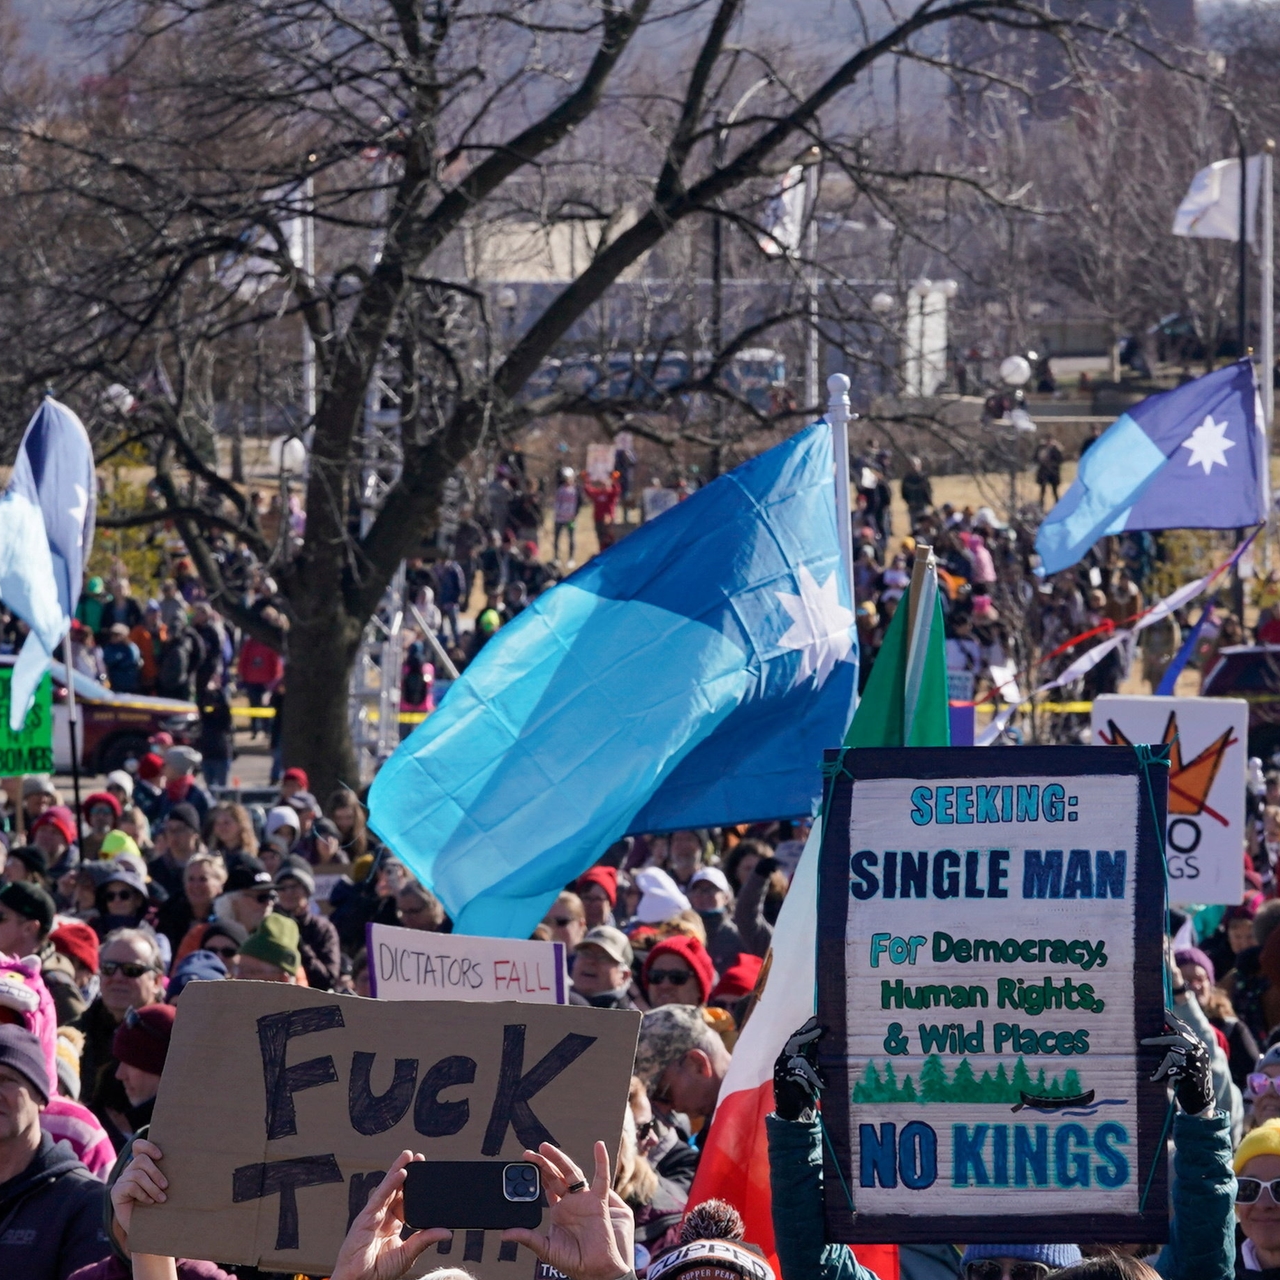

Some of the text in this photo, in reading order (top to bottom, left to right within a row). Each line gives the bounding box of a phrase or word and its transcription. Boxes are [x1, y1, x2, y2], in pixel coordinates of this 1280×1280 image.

[910, 784, 1079, 826] SEEKING:
[850, 850, 1010, 900] SINGLE
[1022, 849, 1128, 900] MAN
[379, 943, 551, 994] DICTATORS FALL
[870, 931, 1108, 971] For Democracy,
[881, 976, 1105, 1016] Human Rights,
[884, 1020, 1090, 1056] & Wild Places
[859, 1120, 1130, 1192] NO KINGS
[715, 1268, 737, 1280] PEAK
